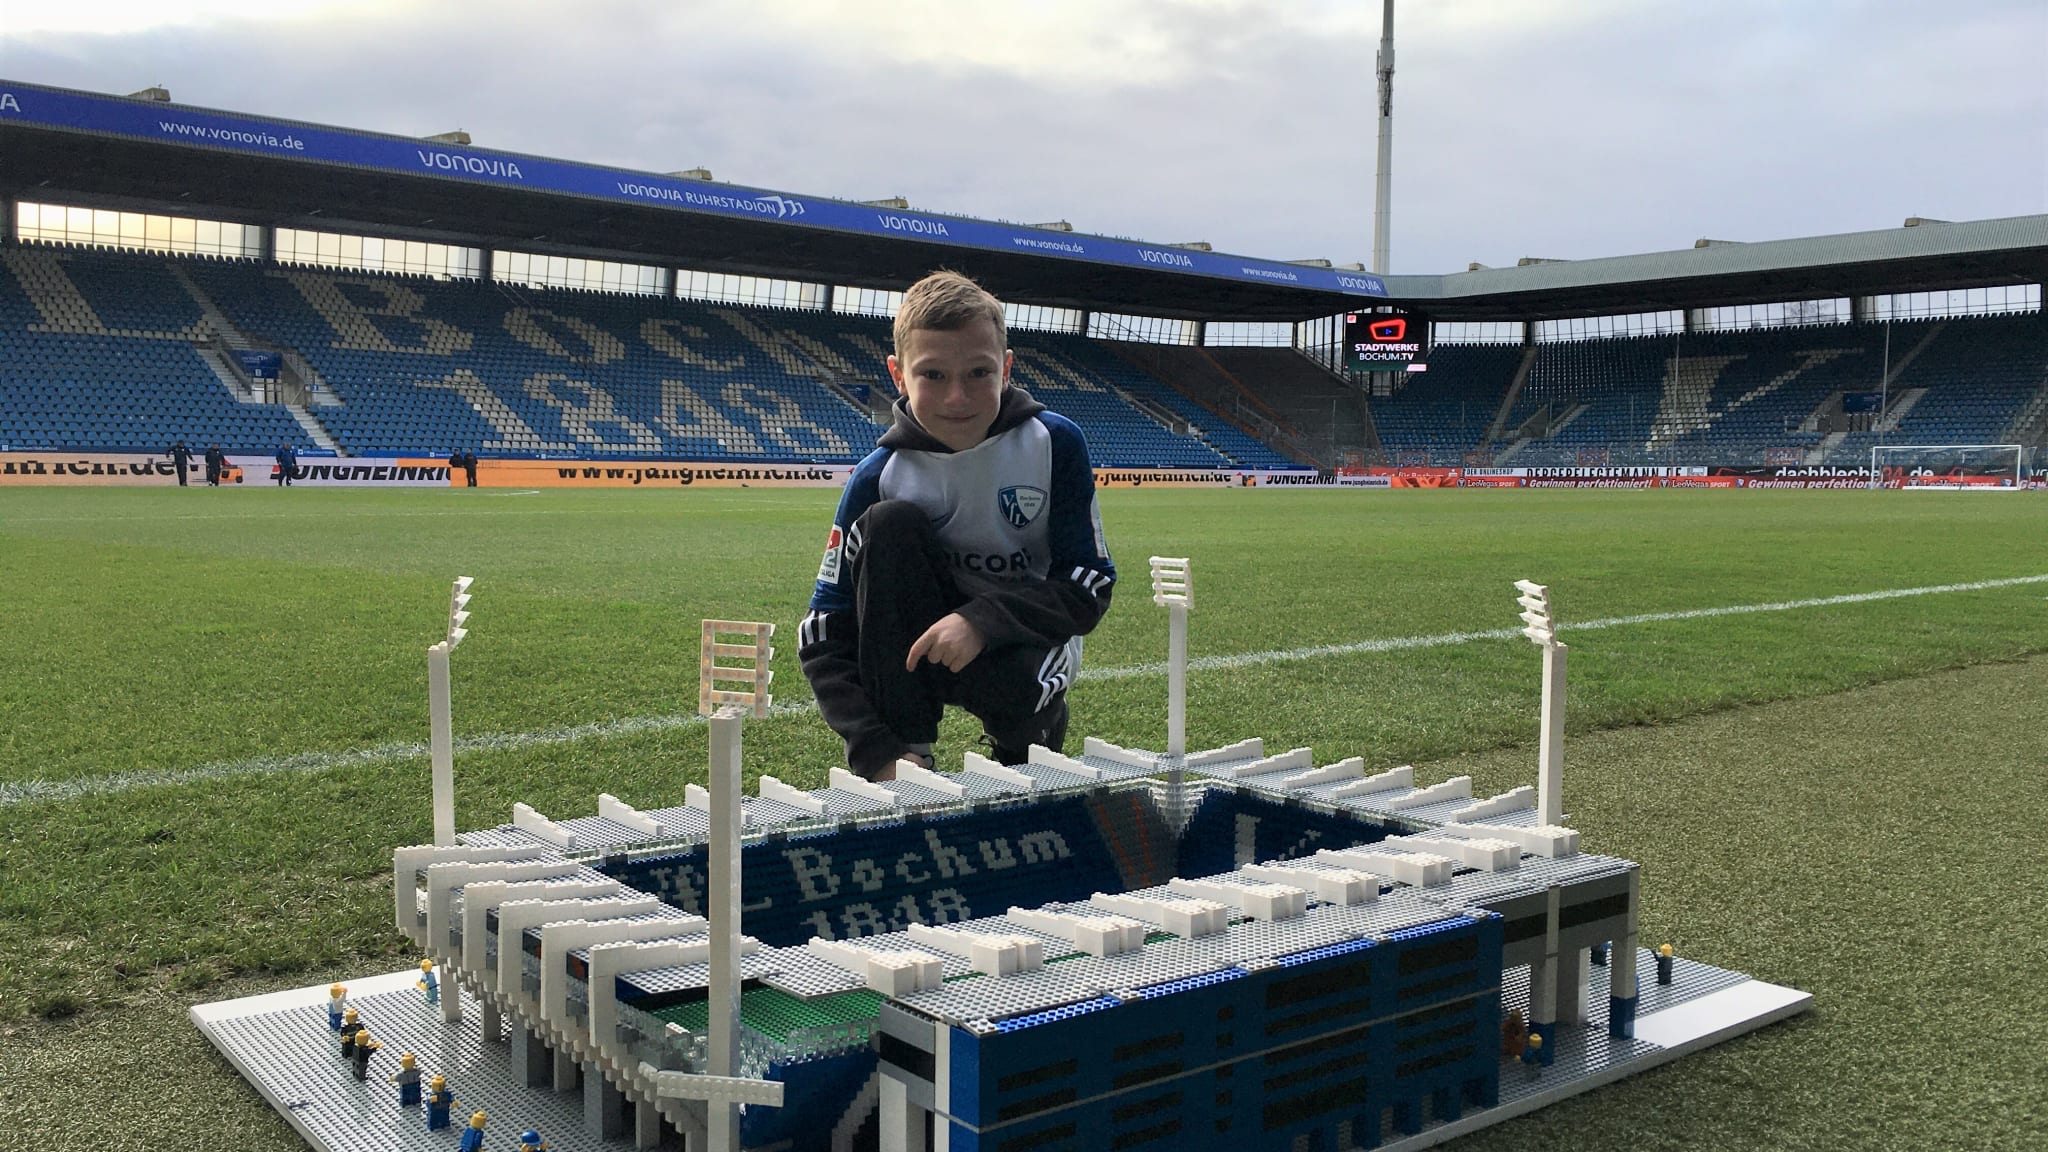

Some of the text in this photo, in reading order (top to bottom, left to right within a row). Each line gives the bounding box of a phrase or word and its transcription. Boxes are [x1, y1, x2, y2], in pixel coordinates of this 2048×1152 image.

[158, 120, 305, 150] www.vonovia.de
[417, 150, 523, 179] VONOVIA
[617, 182, 777, 215] VONOVIA RUHRSTADION
[878, 214, 949, 236] VONOVIA
[1013, 236, 1085, 254] www.vonovia.de
[1138, 249, 1193, 267] VONOVIA
[1242, 266, 1298, 281] www.vonovia.de
[1336, 275, 1382, 292] VONOVIA
[1354, 343, 1419, 352] STADTWERKE
[1359, 352, 1414, 361] BOCHUM.TV
[1529, 479, 1653, 488] Gewinnen perfektioniert!
[1748, 479, 1804, 488] Gewinnen
[782, 829, 1075, 900] Bochum
